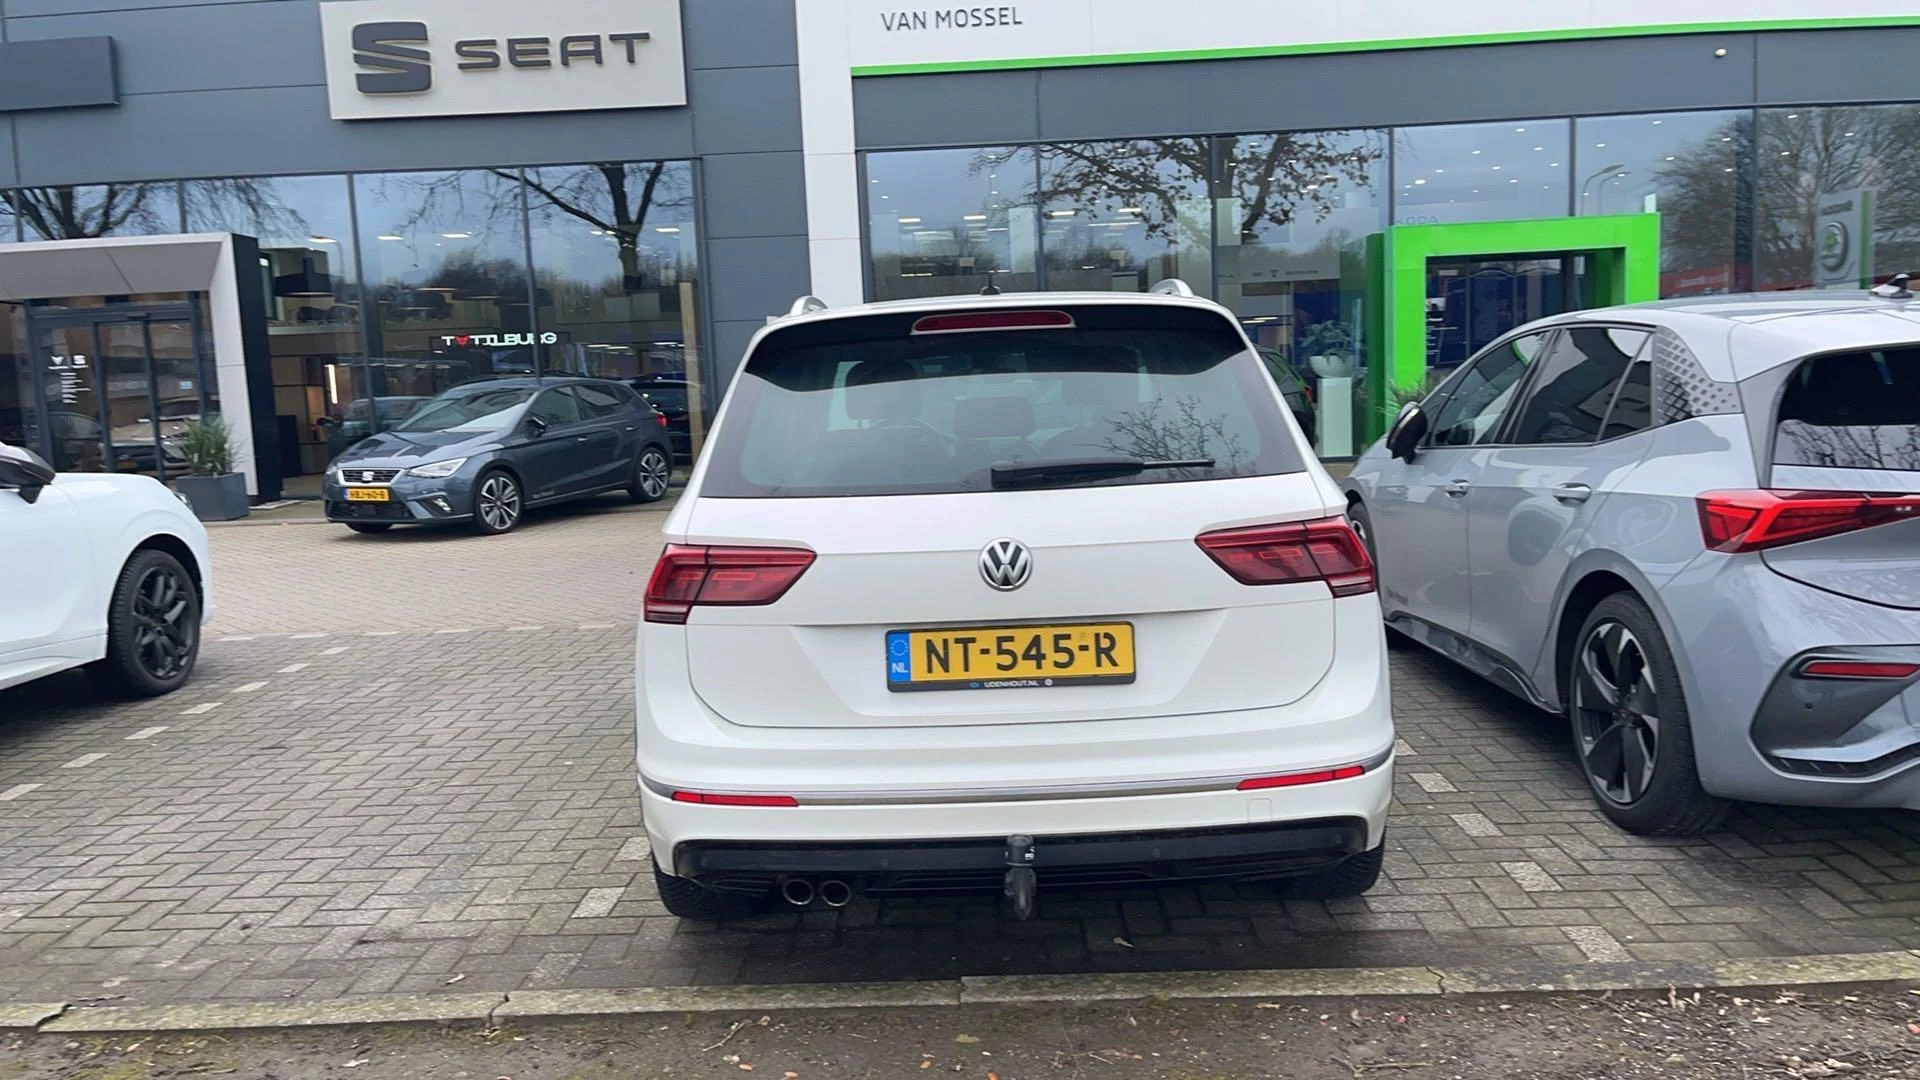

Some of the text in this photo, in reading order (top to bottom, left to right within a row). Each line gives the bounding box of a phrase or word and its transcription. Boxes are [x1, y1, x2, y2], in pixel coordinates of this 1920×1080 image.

[880, 7, 1023, 31] VAN MOSSEL
[455, 32, 650, 70] SEAT
[891, 632, 1120, 674] NL NT-545-R
